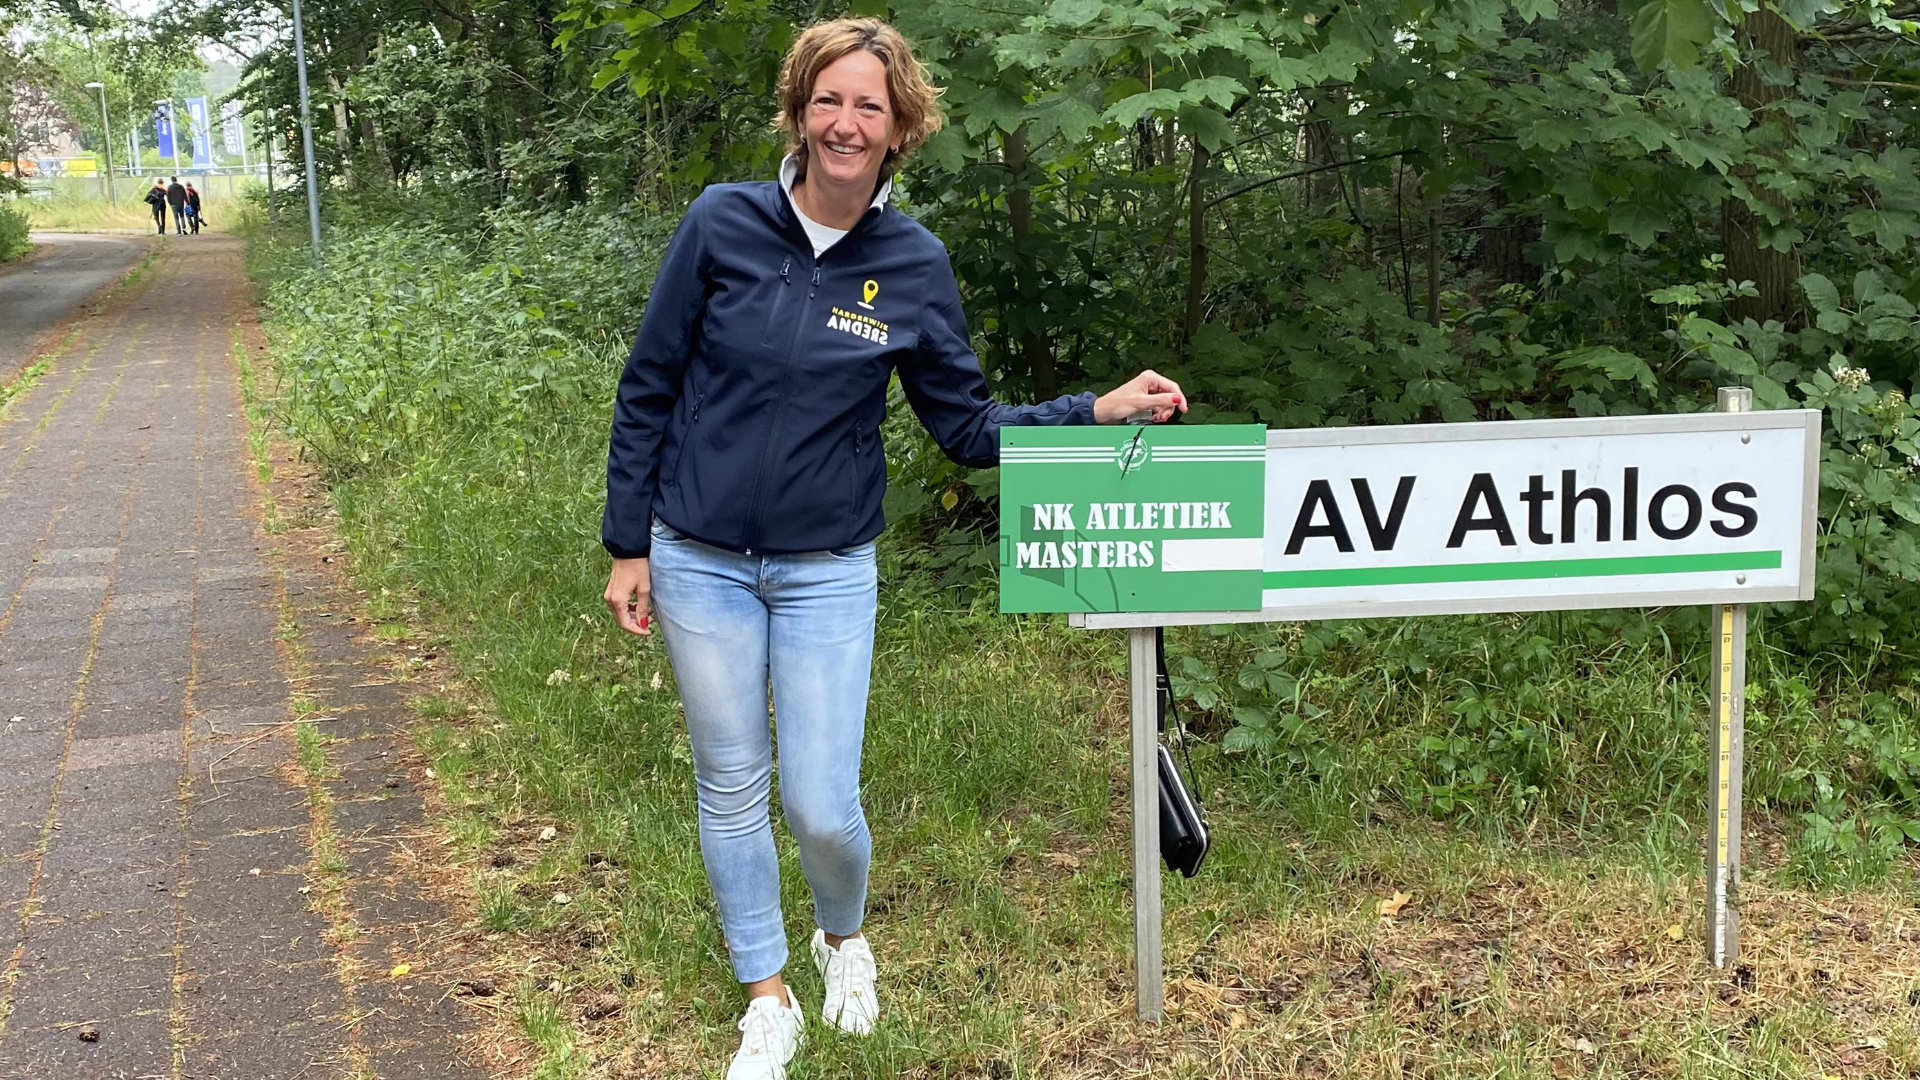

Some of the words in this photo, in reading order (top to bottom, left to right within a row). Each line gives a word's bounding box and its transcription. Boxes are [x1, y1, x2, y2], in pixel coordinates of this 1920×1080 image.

[1032, 503, 1076, 531] NK
[1085, 501, 1232, 530] ATLETIEK
[1283, 475, 1417, 556] AV
[1445, 466, 1758, 549] Athlos
[1015, 540, 1155, 569] MASTERS
